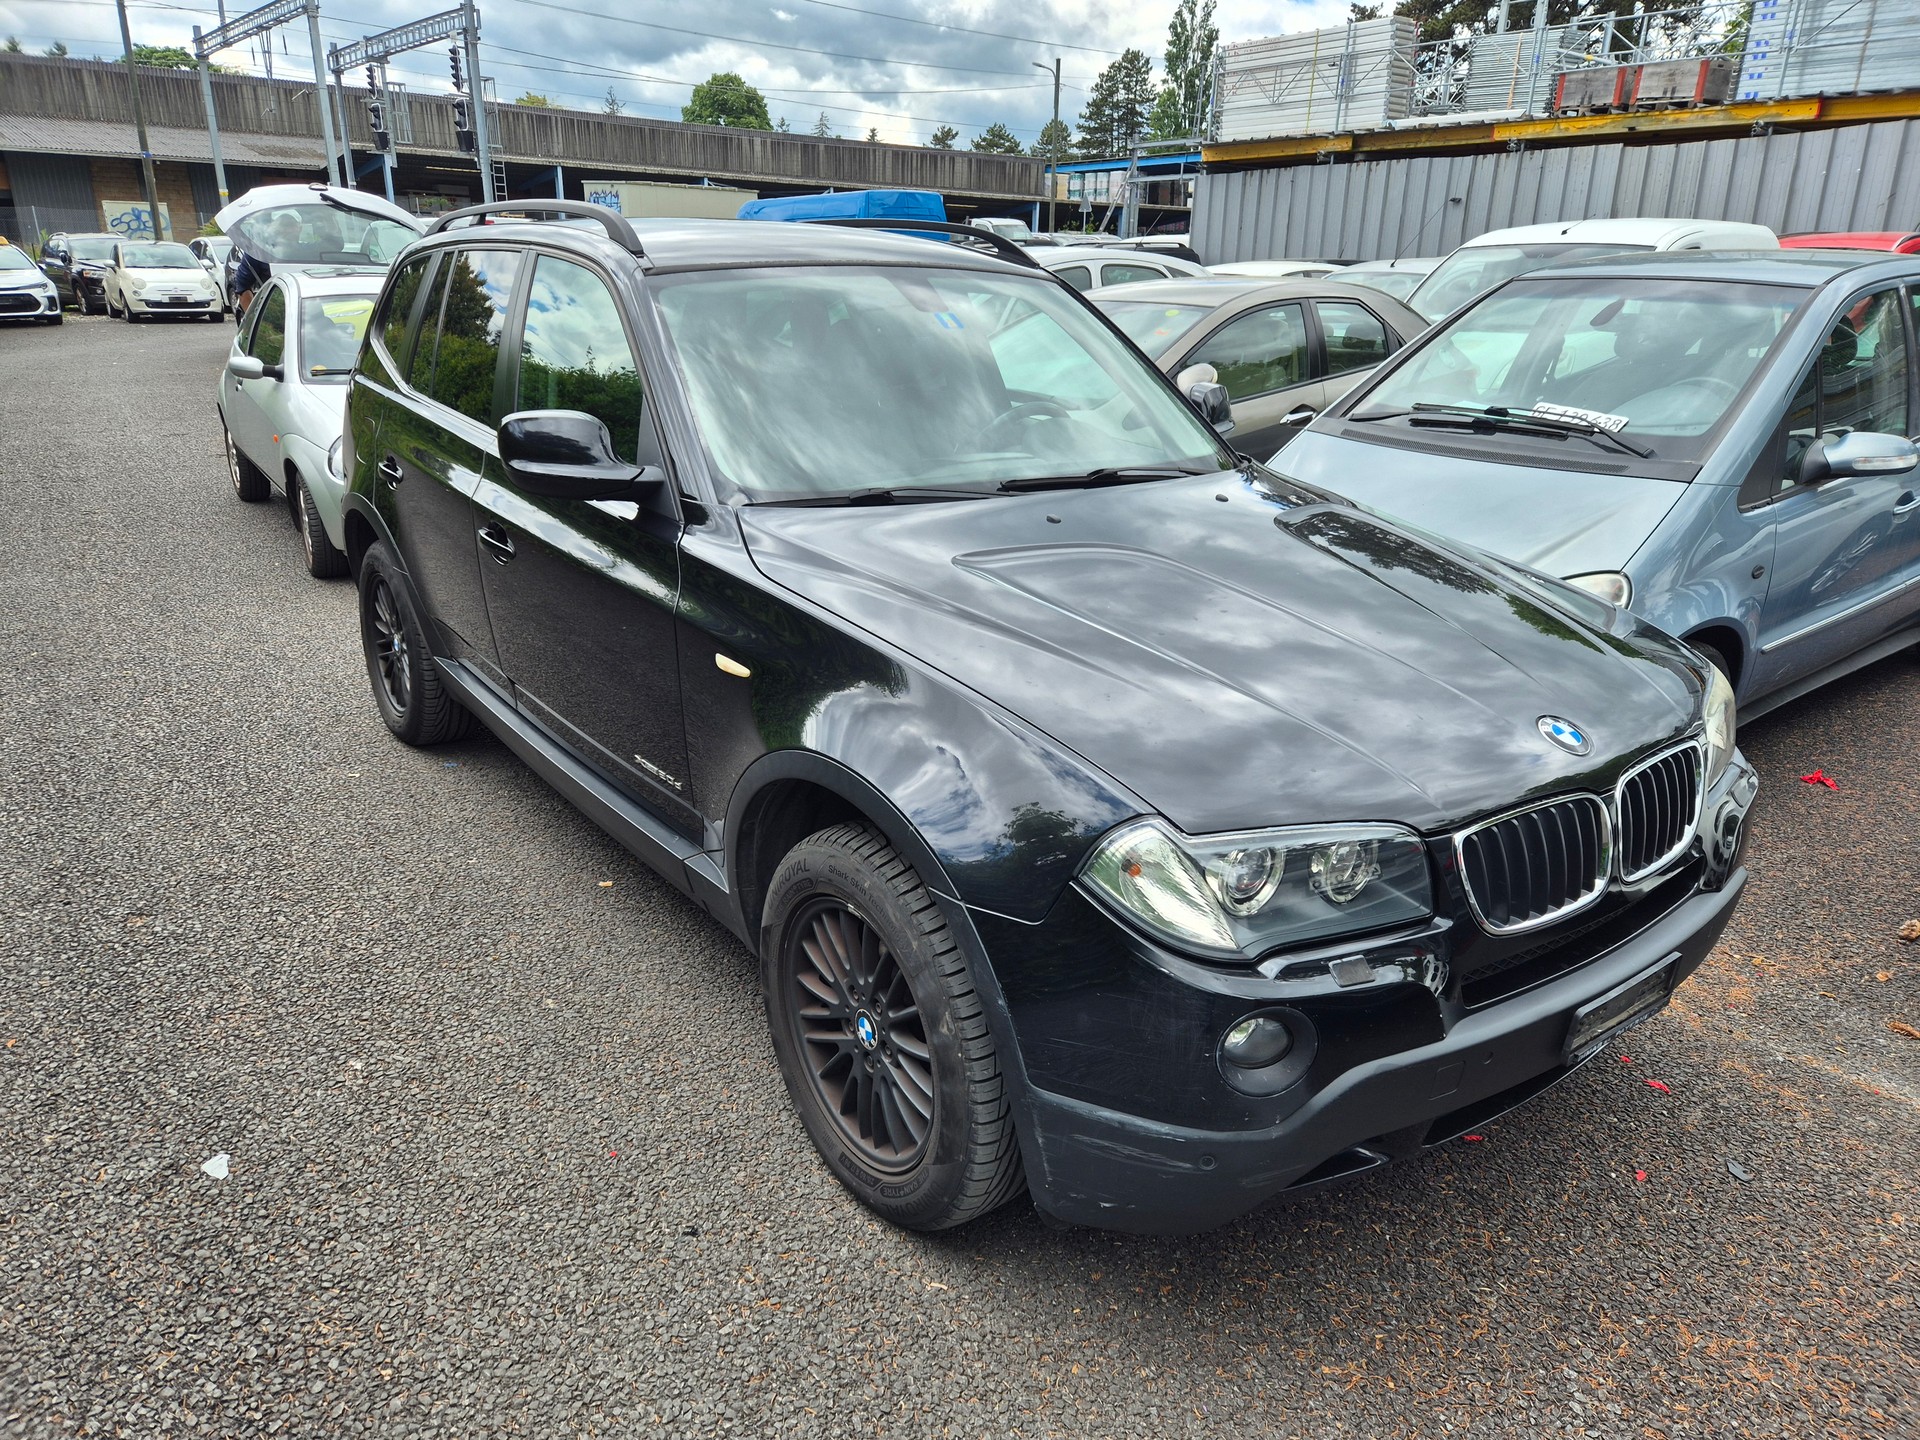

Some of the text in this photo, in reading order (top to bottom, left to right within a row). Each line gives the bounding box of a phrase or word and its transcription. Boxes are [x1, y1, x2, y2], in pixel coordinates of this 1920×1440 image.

[768, 858, 811, 910] UNIROYAL
[828, 864, 850, 882] Shark
[849, 877, 868, 897] Skin
[883, 1186, 900, 1199] TYRE
